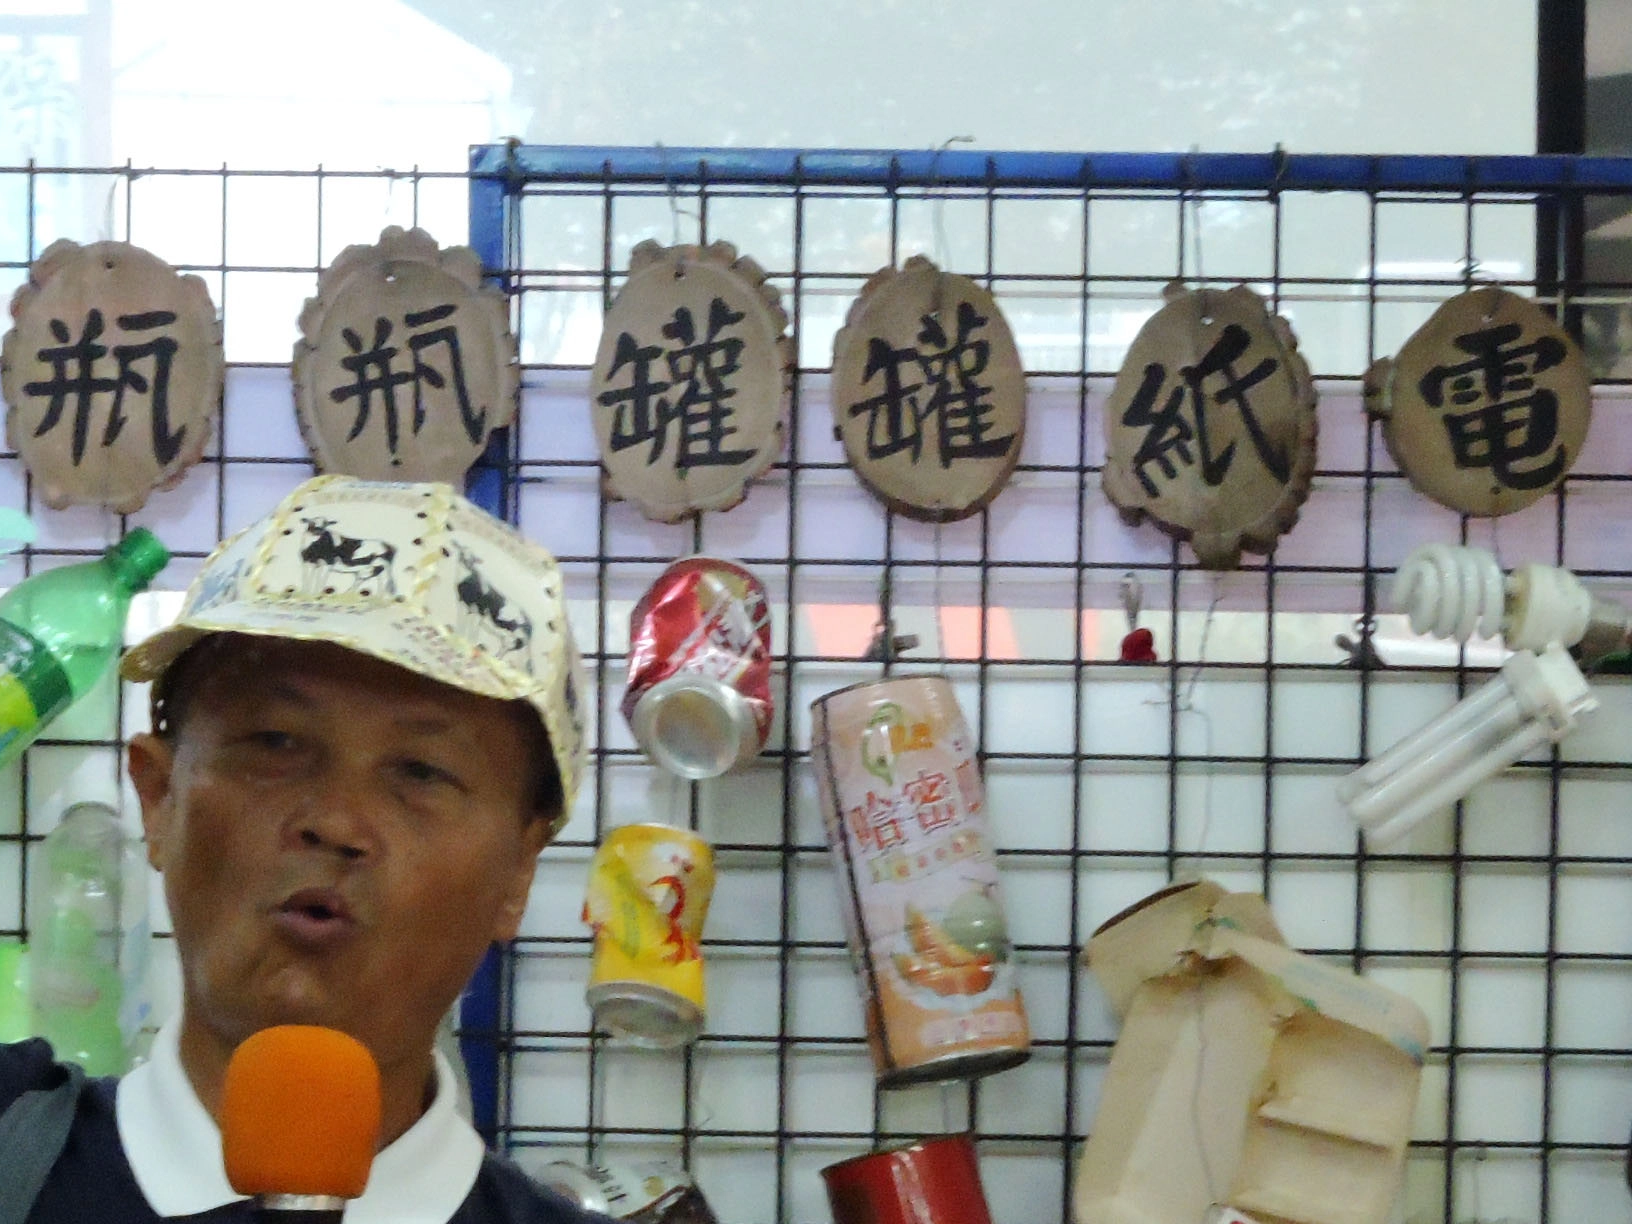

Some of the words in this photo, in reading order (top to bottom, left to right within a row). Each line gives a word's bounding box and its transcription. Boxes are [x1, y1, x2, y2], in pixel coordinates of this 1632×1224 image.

[24, 308, 186, 465] 瓶
[331, 304, 487, 455] 瓶
[598, 297, 758, 468] 罐
[849, 303, 1014, 468] 罐
[1124, 325, 1291, 497] 紙
[1419, 323, 1568, 490] 電
